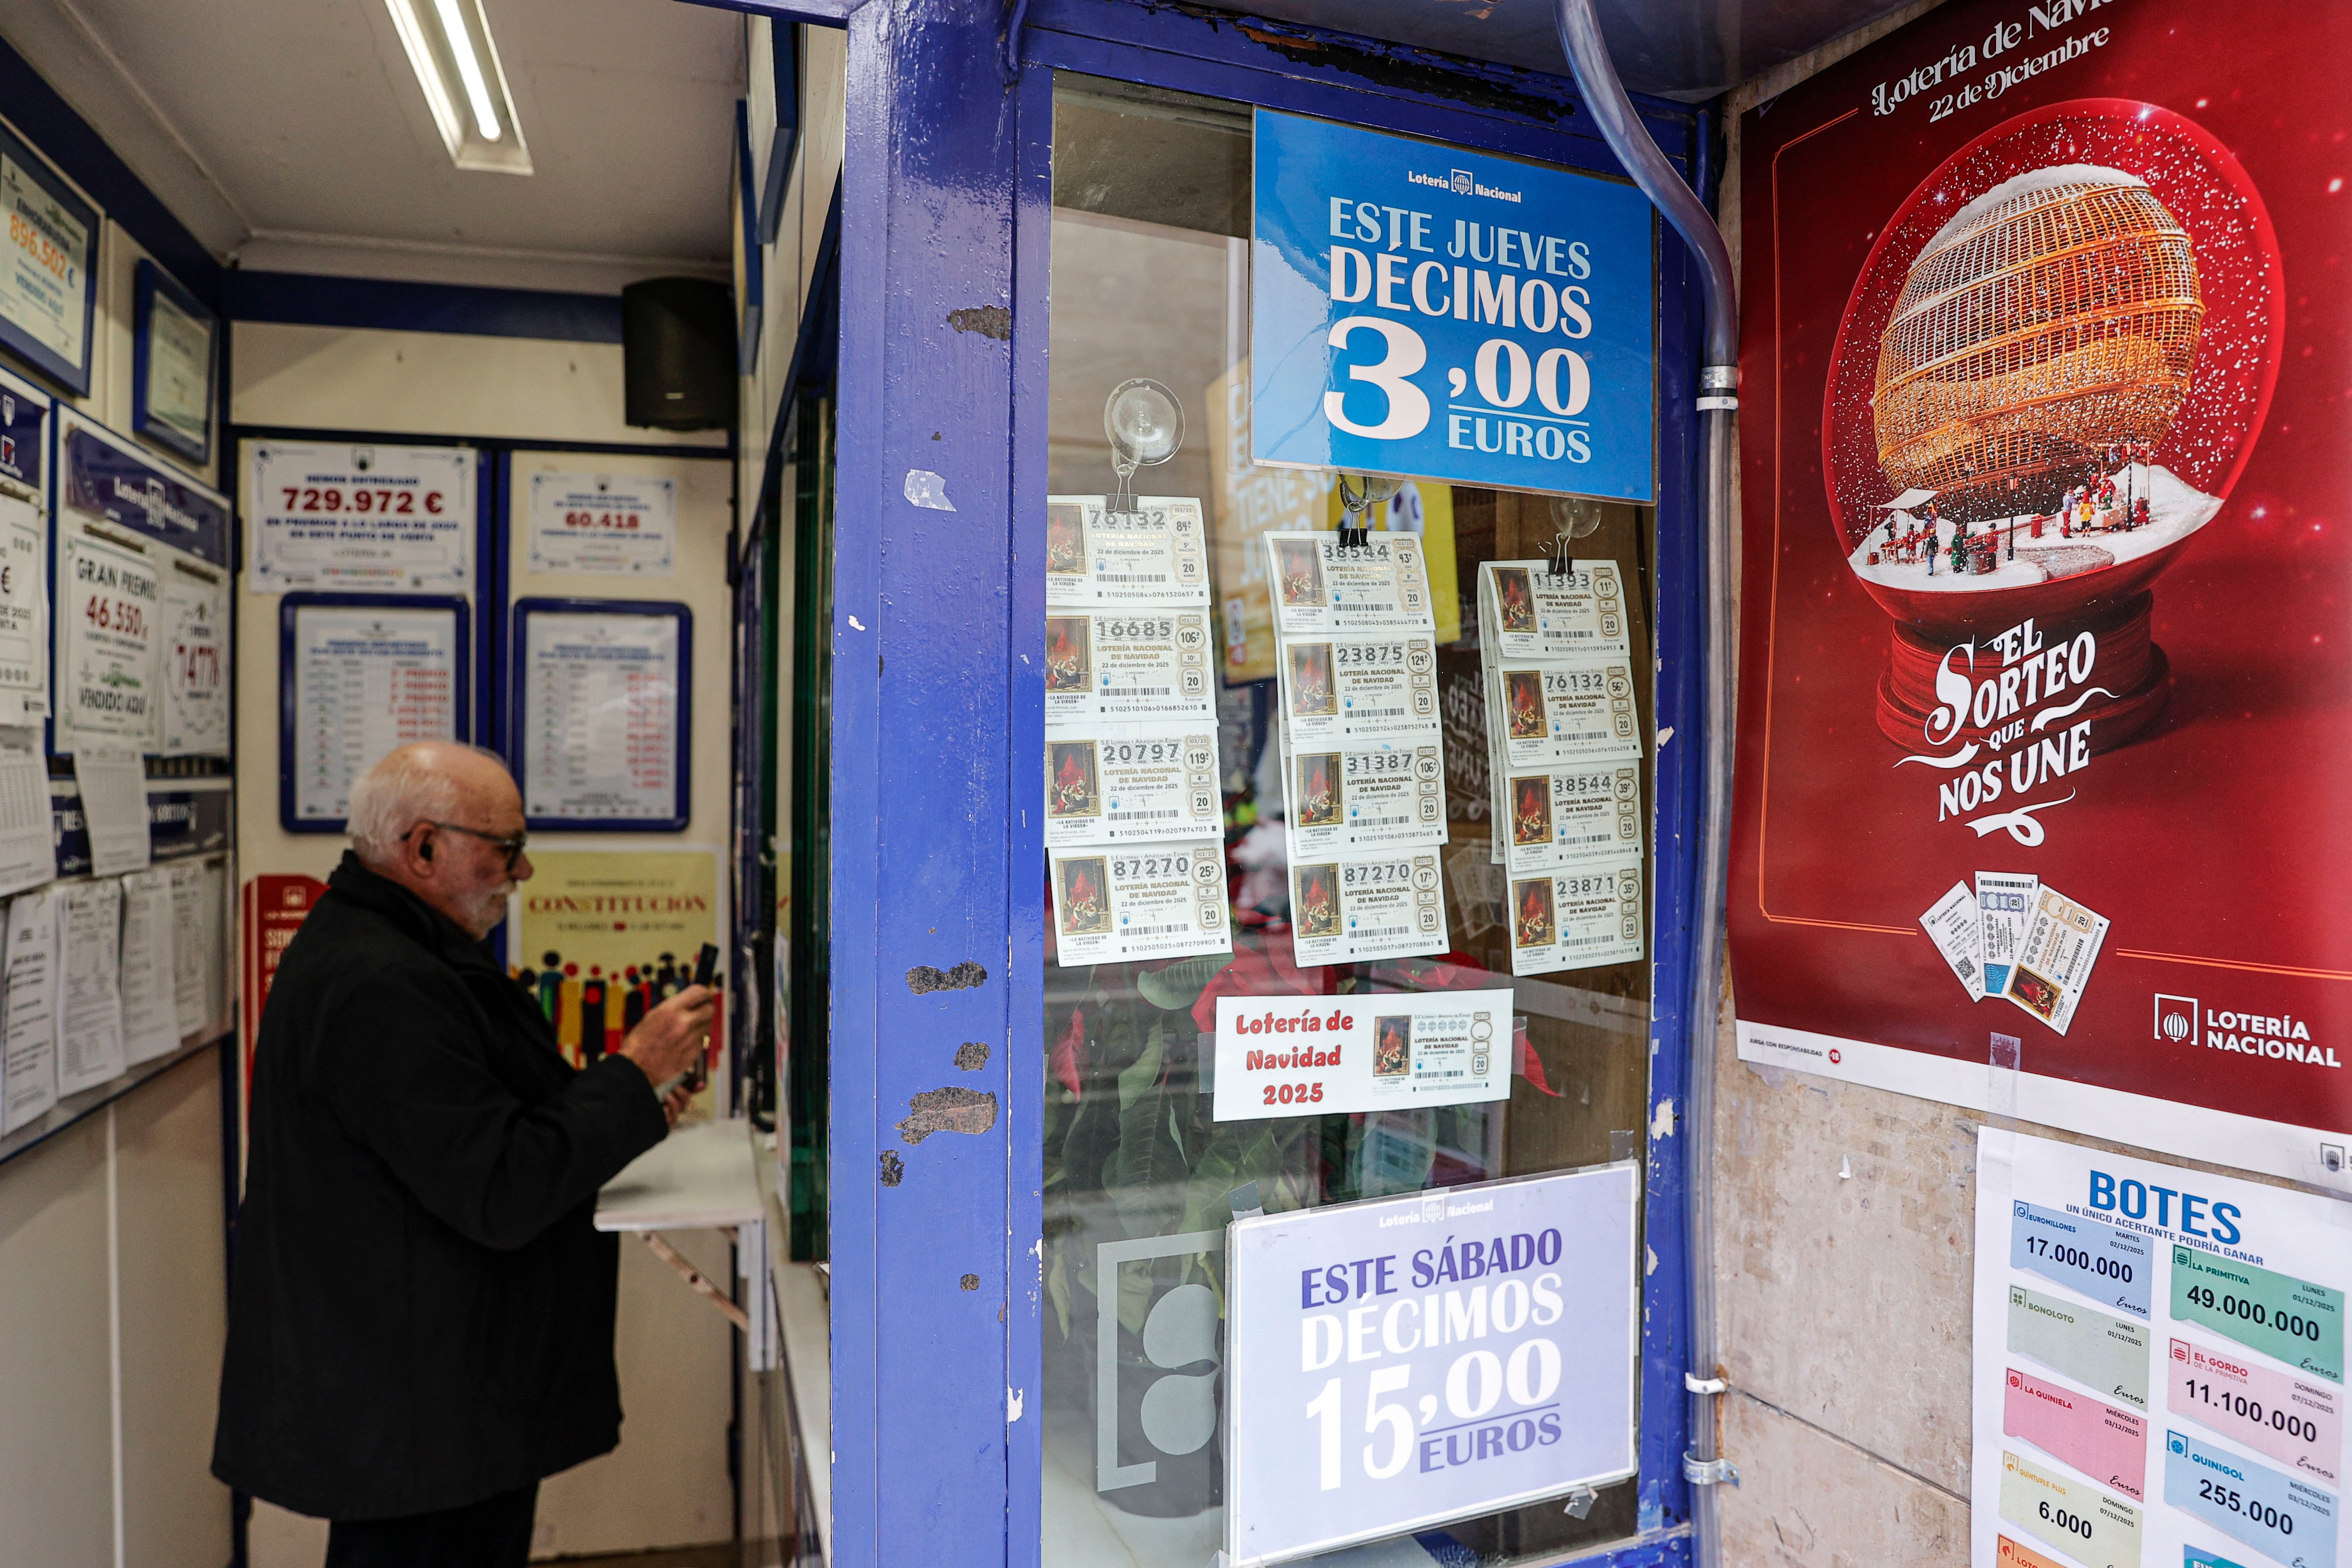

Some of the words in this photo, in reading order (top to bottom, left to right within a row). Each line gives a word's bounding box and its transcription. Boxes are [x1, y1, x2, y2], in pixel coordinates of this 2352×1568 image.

[1871, 44, 1977, 117] Lotería
[1983, 21, 2022, 59] de
[1929, 94, 1954, 123] 22
[1957, 84, 1982, 110] de
[1985, 27, 2110, 99] Diciembre
[1408, 170, 1449, 190] Lotería
[1474, 184, 1522, 203] Nacional
[1329, 197, 1434, 253] ESTE
[1447, 220, 1591, 280] JUEVES
[1329, 242, 1592, 339] DÉCIMOS
[1323, 316, 1591, 439] 3,00
[1448, 414, 1591, 463] EUROS
[282, 488, 413, 513] 729.972
[425, 492, 443, 513] €
[565, 511, 640, 530] 60.418
[1324, 544, 1388, 558] 38544
[1534, 573, 1589, 587] 11393
[1097, 621, 1170, 637] 16685
[1979, 617, 2042, 667] EL
[1338, 646, 1402, 663] 23875
[1545, 674, 1604, 689] 76132
[1924, 631, 2096, 745] SORTEO
[1979, 718, 2025, 751] QUE
[1104, 744, 1178, 761] 20797
[1347, 754, 1412, 772] 31387
[1104, 767, 1138, 776] LOTERÍA
[1939, 760, 2002, 822] NOS
[2010, 720, 2091, 793] UNE
[1554, 776, 1611, 793] 38544
[1197, 798, 1208, 806] 20
[1114, 857, 1188, 876] 87270
[1345, 864, 1409, 882] 87270
[1557, 877, 1614, 895] 23871
[1205, 911, 1216, 920] 20
[2078, 916, 2086, 926] 20
[1236, 1010, 1320, 1035] Lotería
[1326, 1010, 1353, 1032] de
[2207, 1009, 2311, 1041] LOTERÍA
[1247, 1045, 1341, 1071] Navidad
[2207, 1031, 2341, 1068] NACIONAL
[1263, 1082, 1323, 1106] 2025
[1379, 1211, 1420, 1228] Lotería
[1446, 1199, 1494, 1218] Nacional
[2090, 1170, 2241, 1245] BOTES
[2029, 1214, 2076, 1233] EUROMILLONES
[2066, 1204, 2079, 1215] UN
[2083, 1207, 2112, 1223] ÚNICO
[2115, 1218, 2176, 1241] ACERTANTE
[2179, 1234, 2220, 1253] PODRÍA
[2224, 1248, 2264, 1266] GANAR
[2115, 1231, 2139, 1242] MARTES
[2027, 1236, 2133, 1283] 17.000.000
[2110, 1241, 2144, 1256] 02/12/2025
[1302, 1255, 1398, 1309] ESTE
[1412, 1228, 1562, 1289] SÁBADO
[2192, 1262, 2203, 1272] LA
[2206, 1266, 2250, 1285] PRIMITIVA
[2302, 1284, 2325, 1297] LUNES
[2028, 1303, 2074, 1323] BONOLOTO
[2117, 1297, 2147, 1314] Euros
[2187, 1285, 2319, 1341] 49.000.000
[2293, 1294, 2334, 1312] 01/12/2025
[1302, 1272, 1564, 1372] DÉCIMOS
[2116, 1321, 2135, 1333] LUNES
[2108, 1330, 2142, 1346] 01/12/2025
[2194, 1353, 2206, 1363] EL
[2209, 1358, 2248, 1377] GORDO
[2300, 1357, 2339, 1379] Euros
[2216, 1369, 2248, 1385] PRIMITIVA
[2025, 1385, 2034, 1394] LA
[2036, 1390, 2073, 1409] QUINIELA
[2114, 1385, 2145, 1404] Euros
[2295, 1383, 2332, 1400] DOMINGO
[1306, 1338, 1562, 1491] 15,00
[2106, 1408, 2139, 1425] MIÉRCOLES
[2186, 1379, 2316, 1442] 11.100.000
[2105, 1419, 2139, 1437] 03/12/2025
[1420, 1413, 1562, 1474] EUROS
[2192, 1454, 2244, 1481] QUINIGOL
[2297, 1456, 2334, 1479] Euros
[2052, 1484, 2066, 1495] PLUS
[2110, 1475, 2140, 1496] Euros
[2103, 1496, 2133, 1515] DOMINGO
[2200, 1479, 2293, 1535] 255.000
[2039, 1501, 2092, 1539] 6.000
[2100, 1508, 2134, 1528] 07/12/2025
